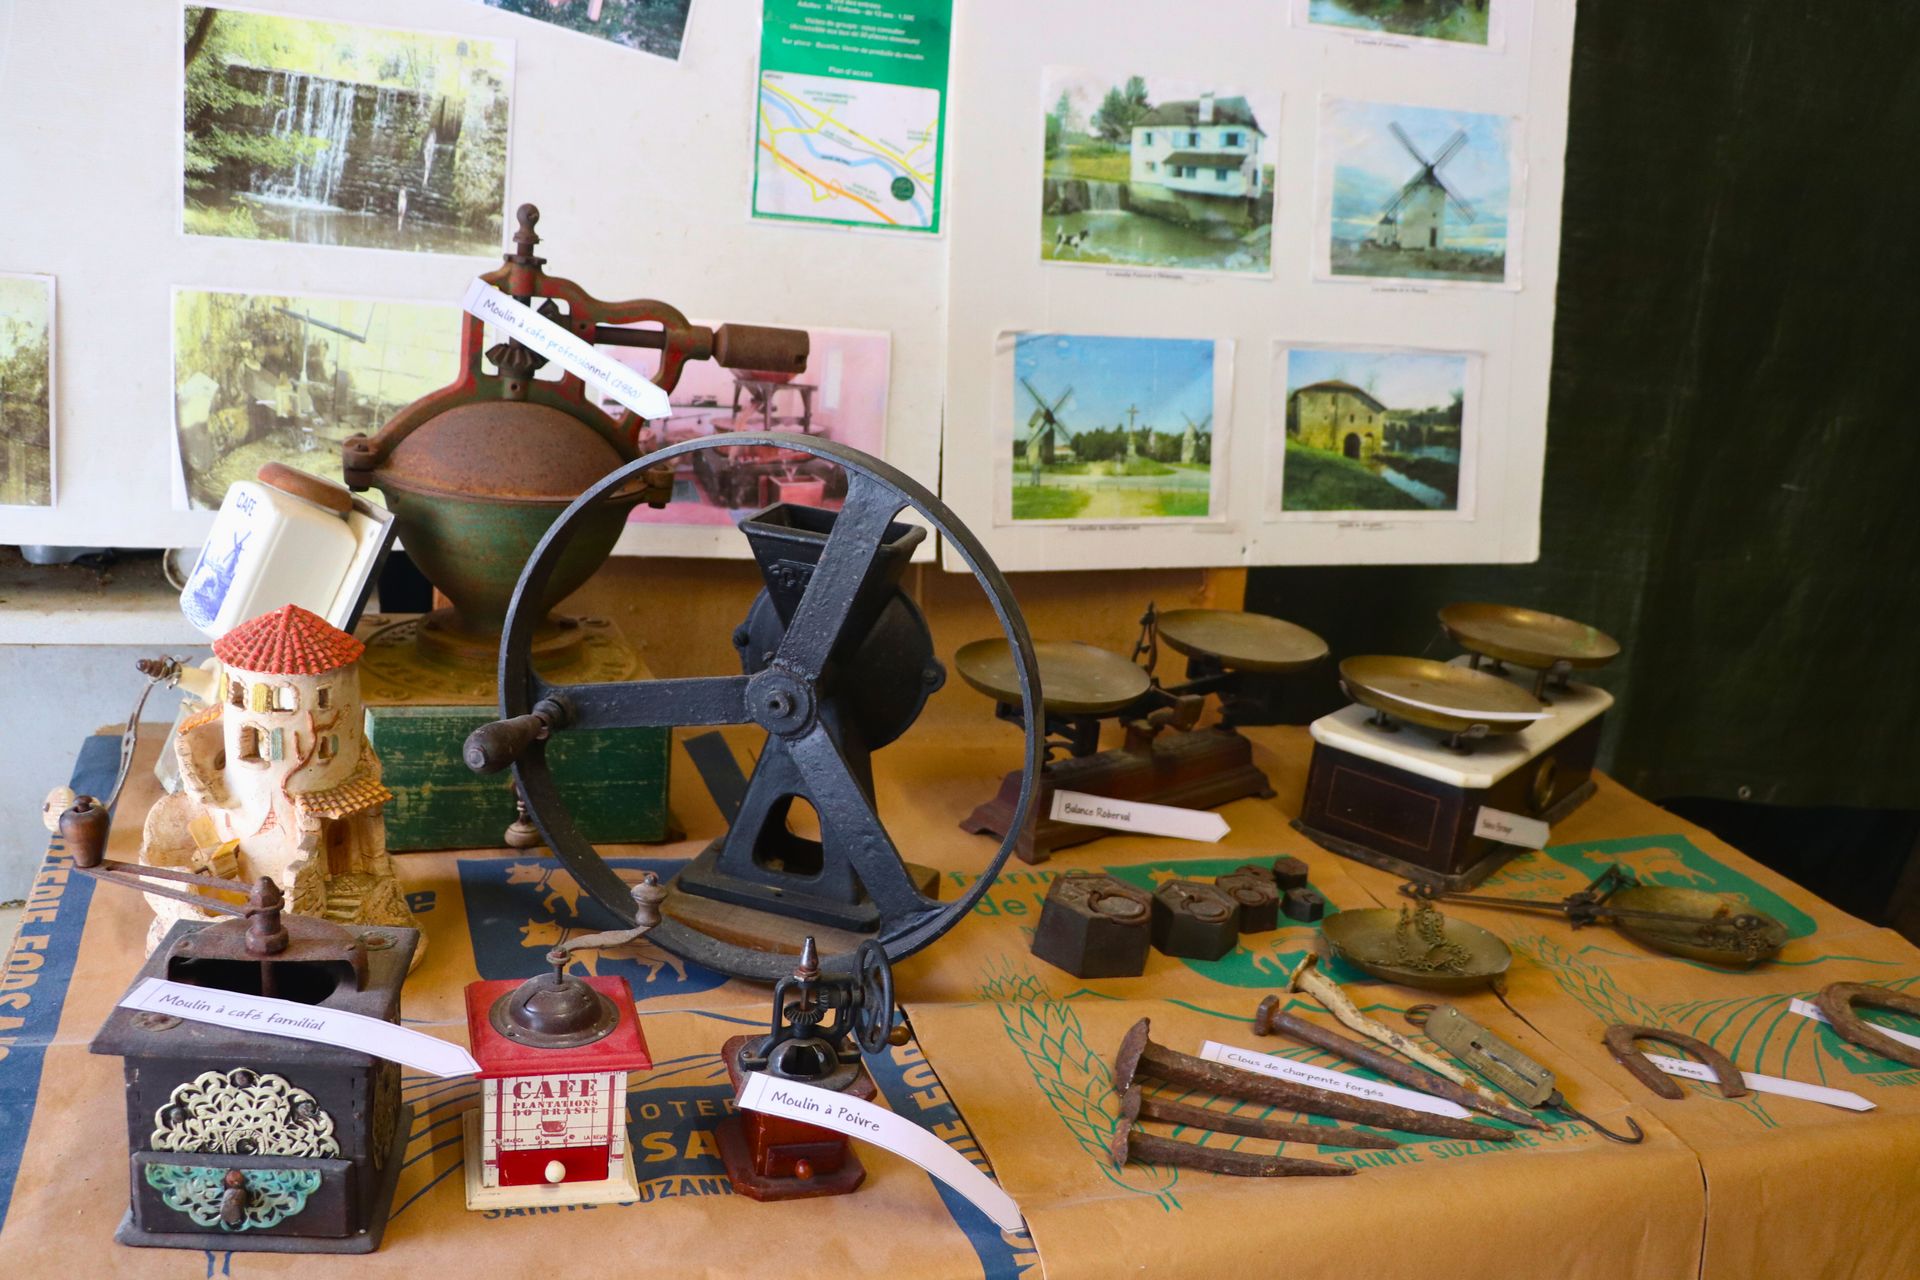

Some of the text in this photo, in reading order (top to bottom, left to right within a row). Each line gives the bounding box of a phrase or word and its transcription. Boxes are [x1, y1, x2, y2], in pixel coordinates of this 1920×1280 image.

[483, 299, 516, 323] Moulin
[518, 318, 525, 329] à
[547, 338, 612, 381] professionnel
[1063, 802, 1132, 822] Balance Roberval
[159, 994, 327, 1031] Moulin à café familial
[1227, 1052, 1261, 1068] Clous
[1264, 1062, 1280, 1072] de
[1283, 1066, 1342, 1087] charpente
[512, 1079, 599, 1100] CAFE
[512, 1099, 599, 1110] PLANTATIONS
[512, 1107, 599, 1117] DO BRASIL
[771, 1090, 881, 1132] Moulin à Poivre
[1333, 1144, 1424, 1169] SAINTE
